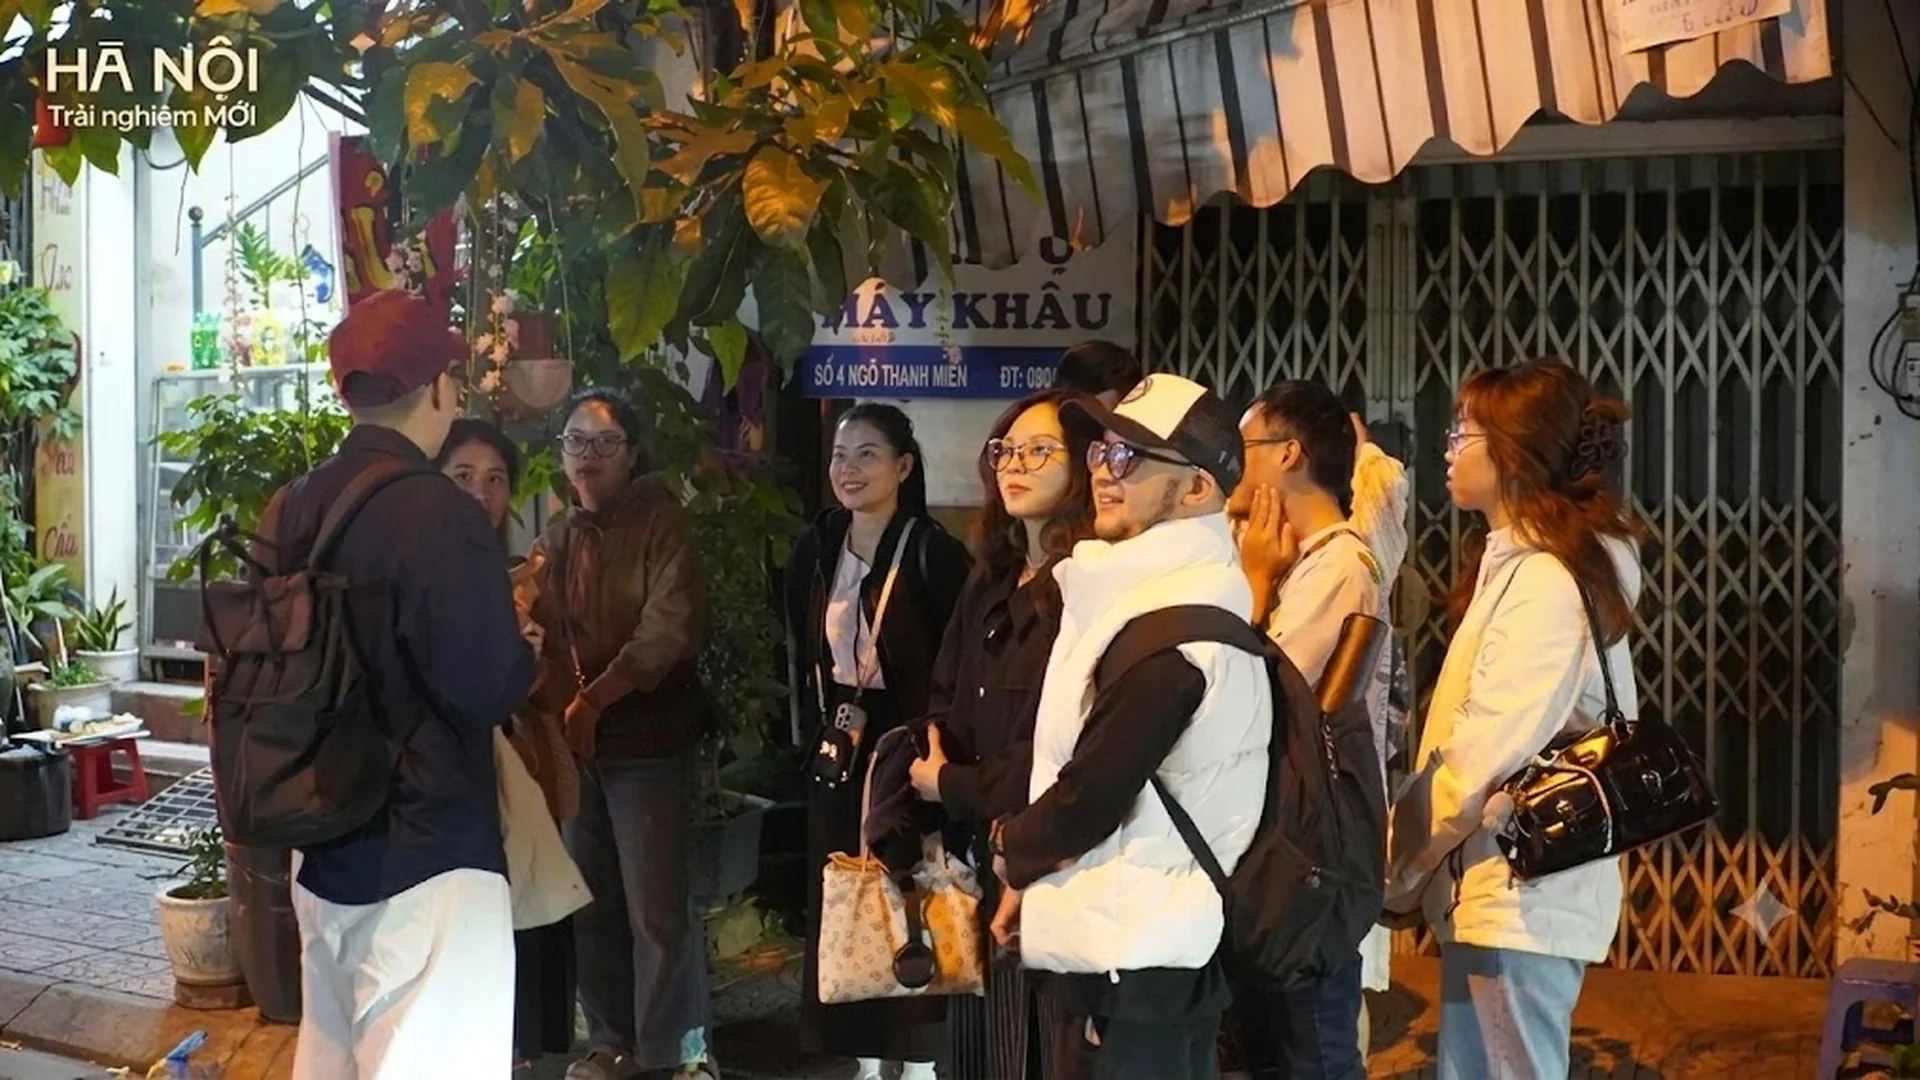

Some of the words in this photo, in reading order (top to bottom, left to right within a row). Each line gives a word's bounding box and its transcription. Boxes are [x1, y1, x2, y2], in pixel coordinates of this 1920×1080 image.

[952, 281, 1112, 330] KHÂU
[836, 365, 845, 386] 4
[882, 364, 929, 387] THANH
